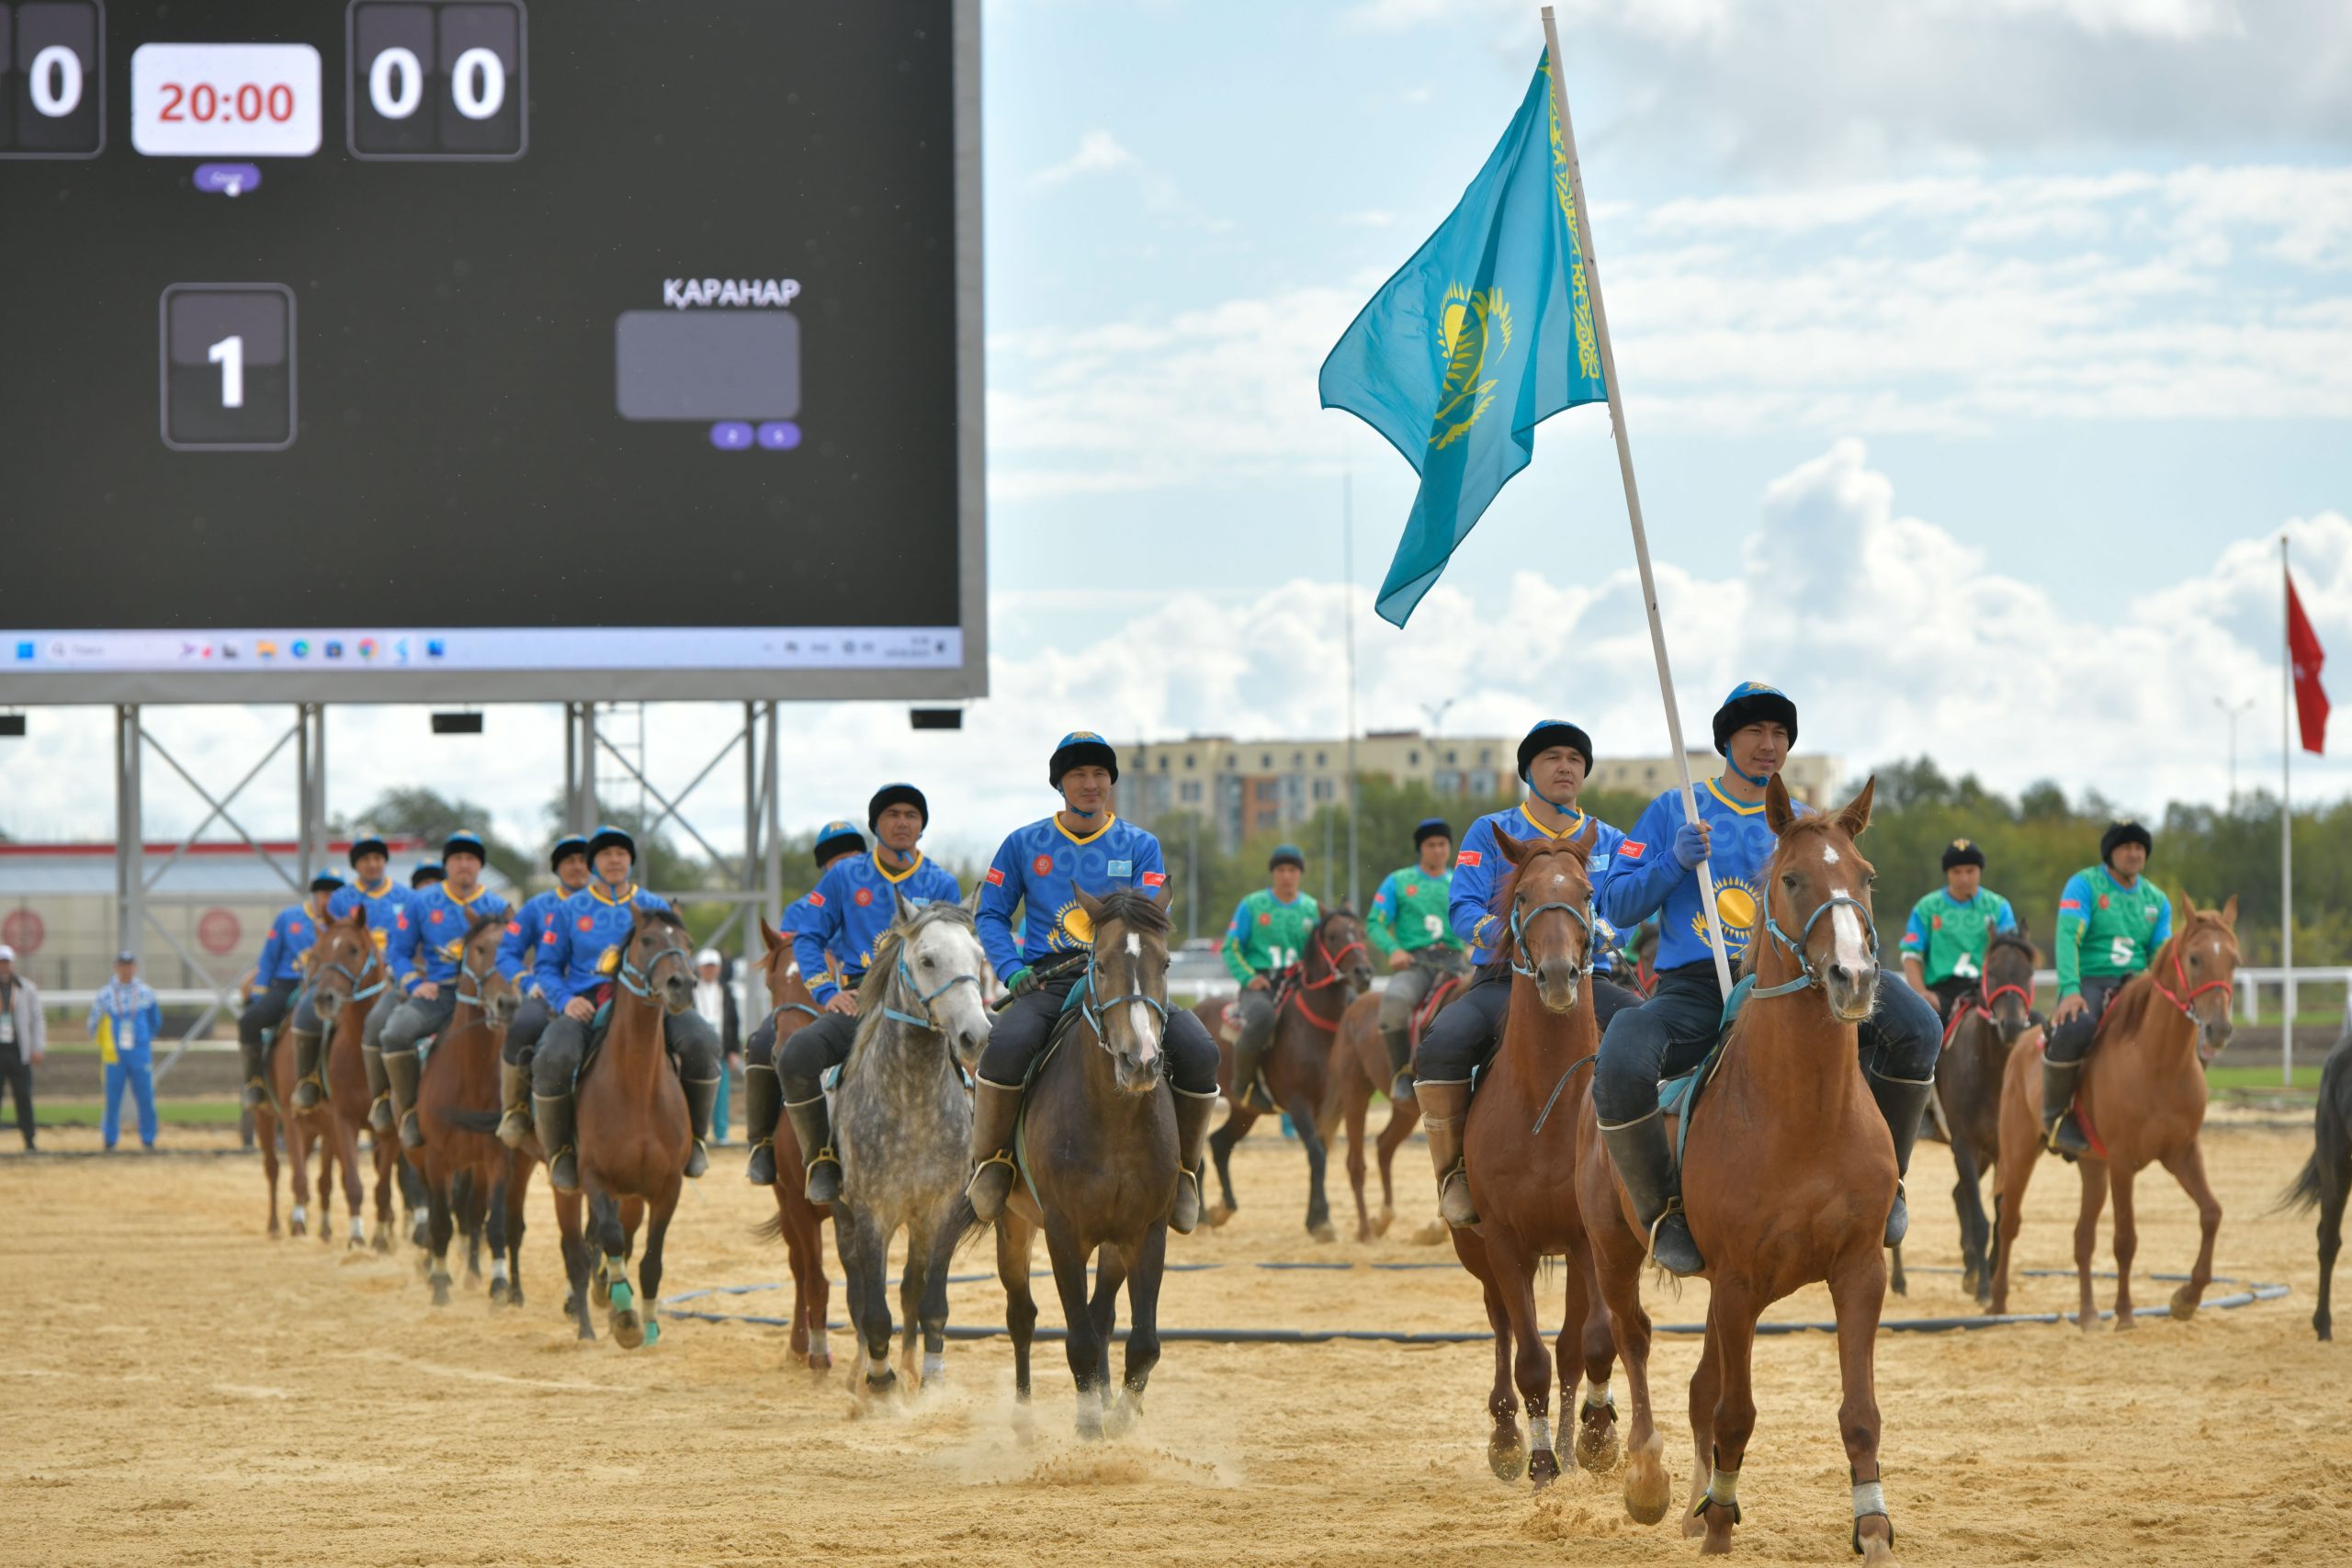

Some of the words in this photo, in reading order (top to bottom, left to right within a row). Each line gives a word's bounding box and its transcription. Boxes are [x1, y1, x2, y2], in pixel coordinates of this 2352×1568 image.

[29, 45, 83, 118] 0
[158, 83, 295, 123] 20:00
[663, 278, 801, 310] ҚАРАНАР
[209, 335, 243, 408] 1
[1424, 914, 1444, 940] 9
[1952, 952, 1980, 979] 6
[2109, 936, 2135, 966] 5
